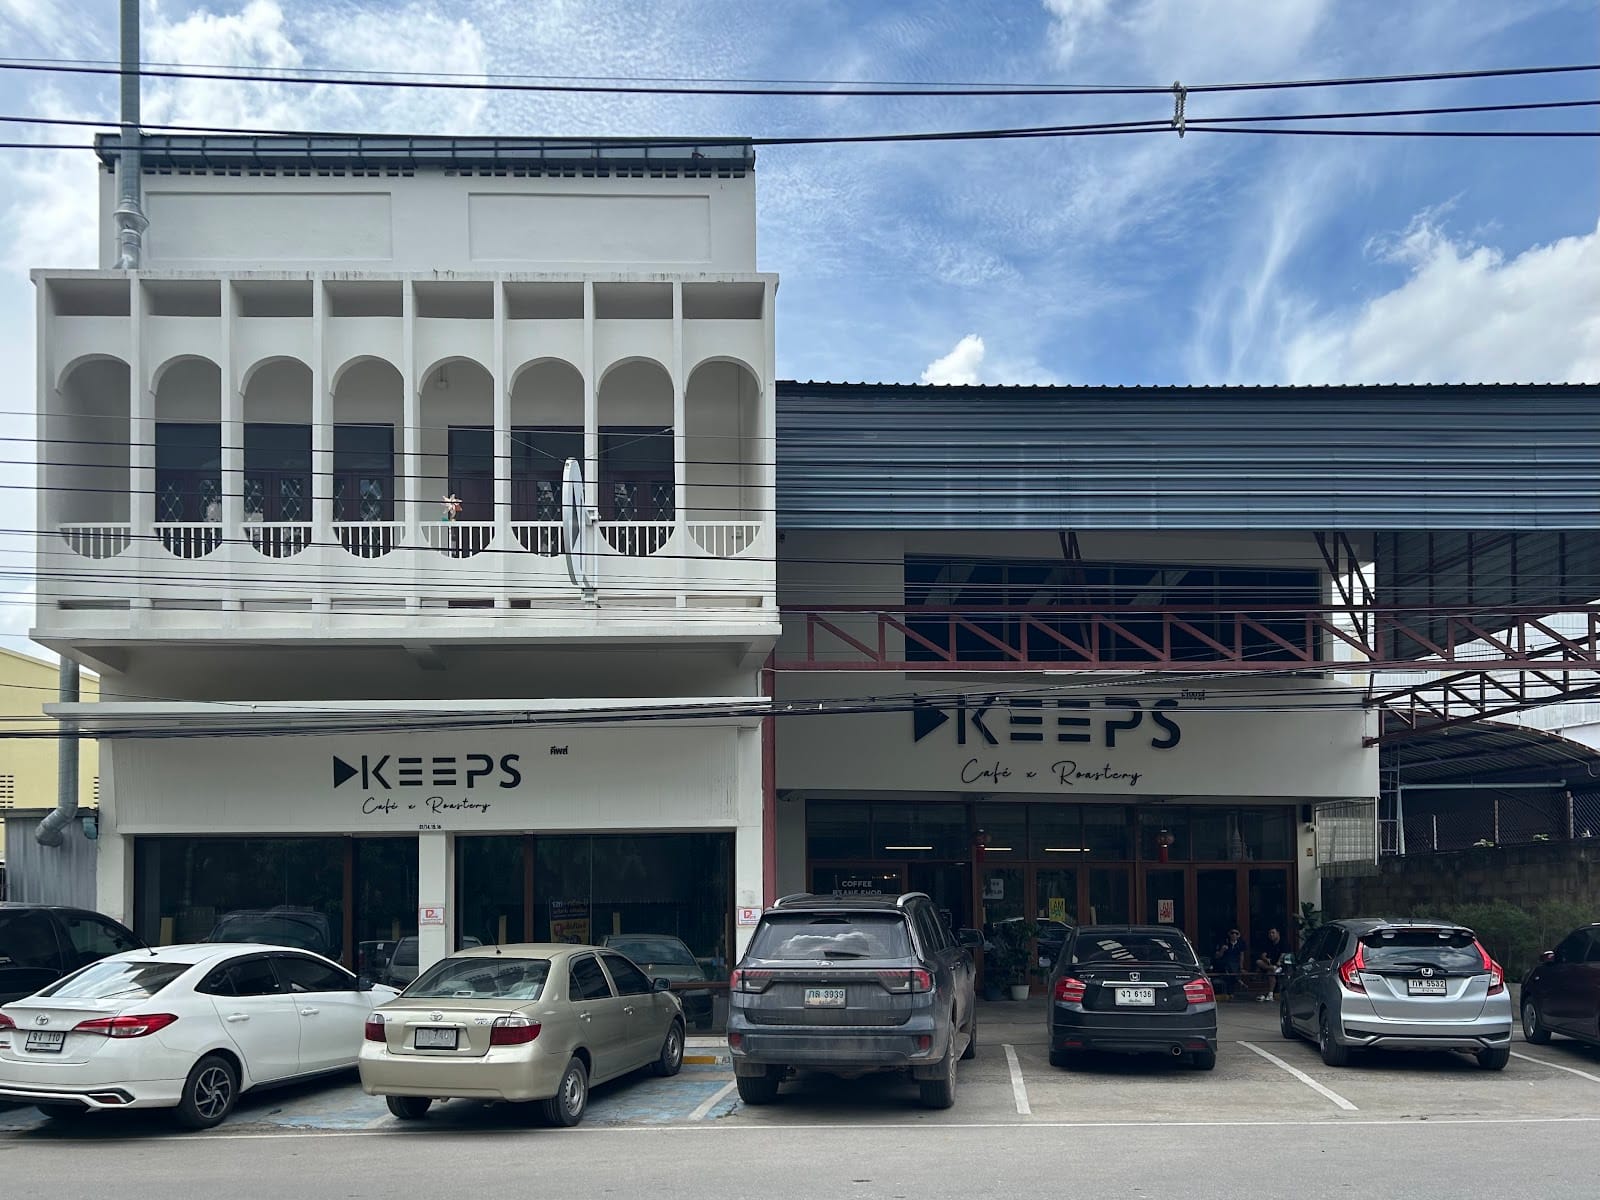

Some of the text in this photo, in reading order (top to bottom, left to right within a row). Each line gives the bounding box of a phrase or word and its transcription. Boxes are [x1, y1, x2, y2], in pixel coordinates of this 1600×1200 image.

[957, 695, 1181, 749] KEEPS
[361, 754, 522, 790] KEEPS
[961, 758, 1012, 784] Café
[1051, 760, 1142, 786] Roastery
[362, 796, 398, 815] Café
[425, 796, 491, 814] Roastery
[841, 880, 873, 888] COFFEE
[824, 990, 844, 999] 3939
